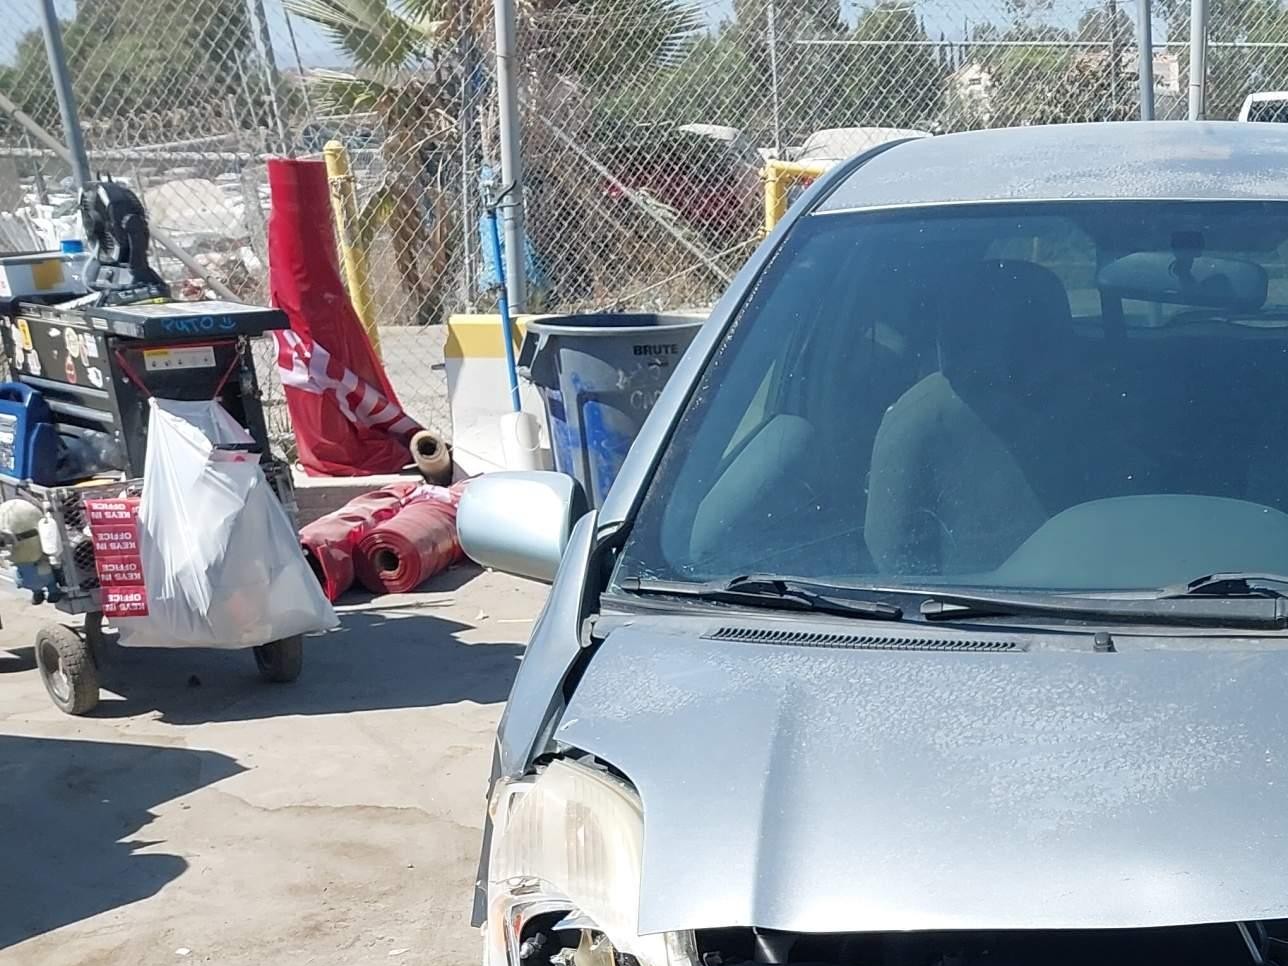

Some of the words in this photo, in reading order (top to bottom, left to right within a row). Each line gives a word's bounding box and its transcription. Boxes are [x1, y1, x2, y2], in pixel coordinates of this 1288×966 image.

[632, 343, 679, 356] BRUTE
[92, 502, 126, 510] OFFICE
[97, 532, 132, 540] OFFICE
[110, 542, 136, 550] KEYS
[102, 563, 137, 571] OFFICE
[107, 593, 142, 602] OFFICE
[119, 602, 145, 611] KEYS
